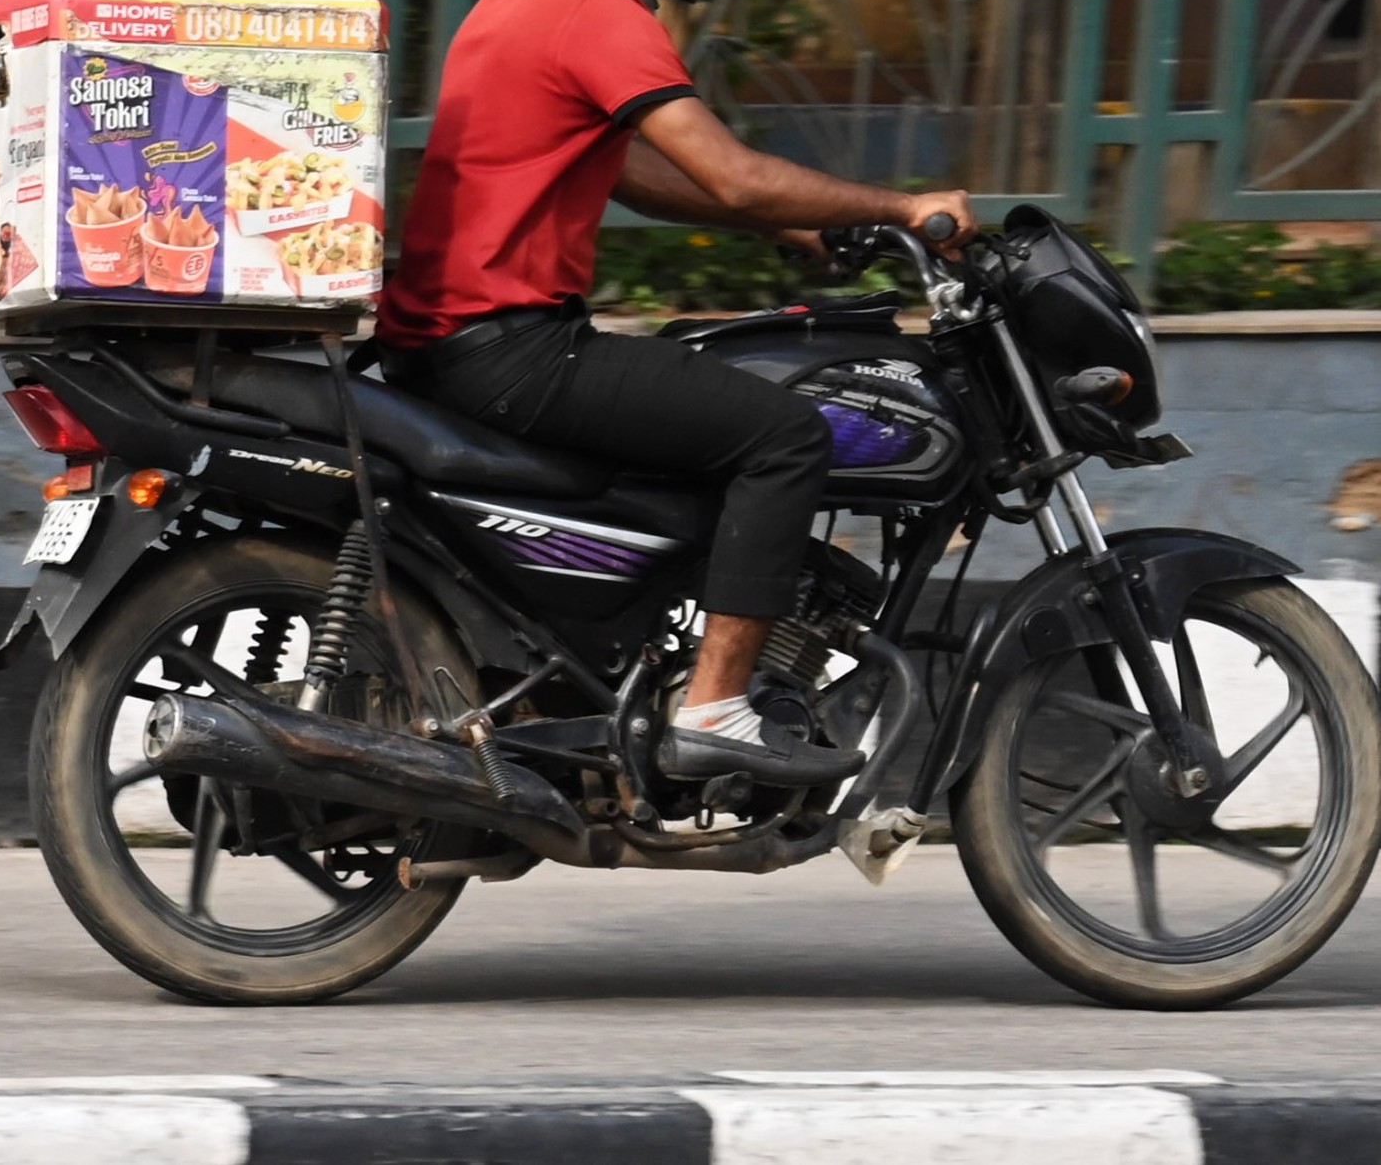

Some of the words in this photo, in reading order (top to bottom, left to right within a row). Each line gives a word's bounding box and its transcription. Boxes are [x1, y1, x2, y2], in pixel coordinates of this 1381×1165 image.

[113, 4, 173, 20] HOME
[75, 21, 172, 38] DELIVERY
[69, 76, 153, 105] Samosa
[90, 100, 149, 131] Tokri
[853, 364, 926, 389] HONDA
[476, 514, 552, 538] 110
